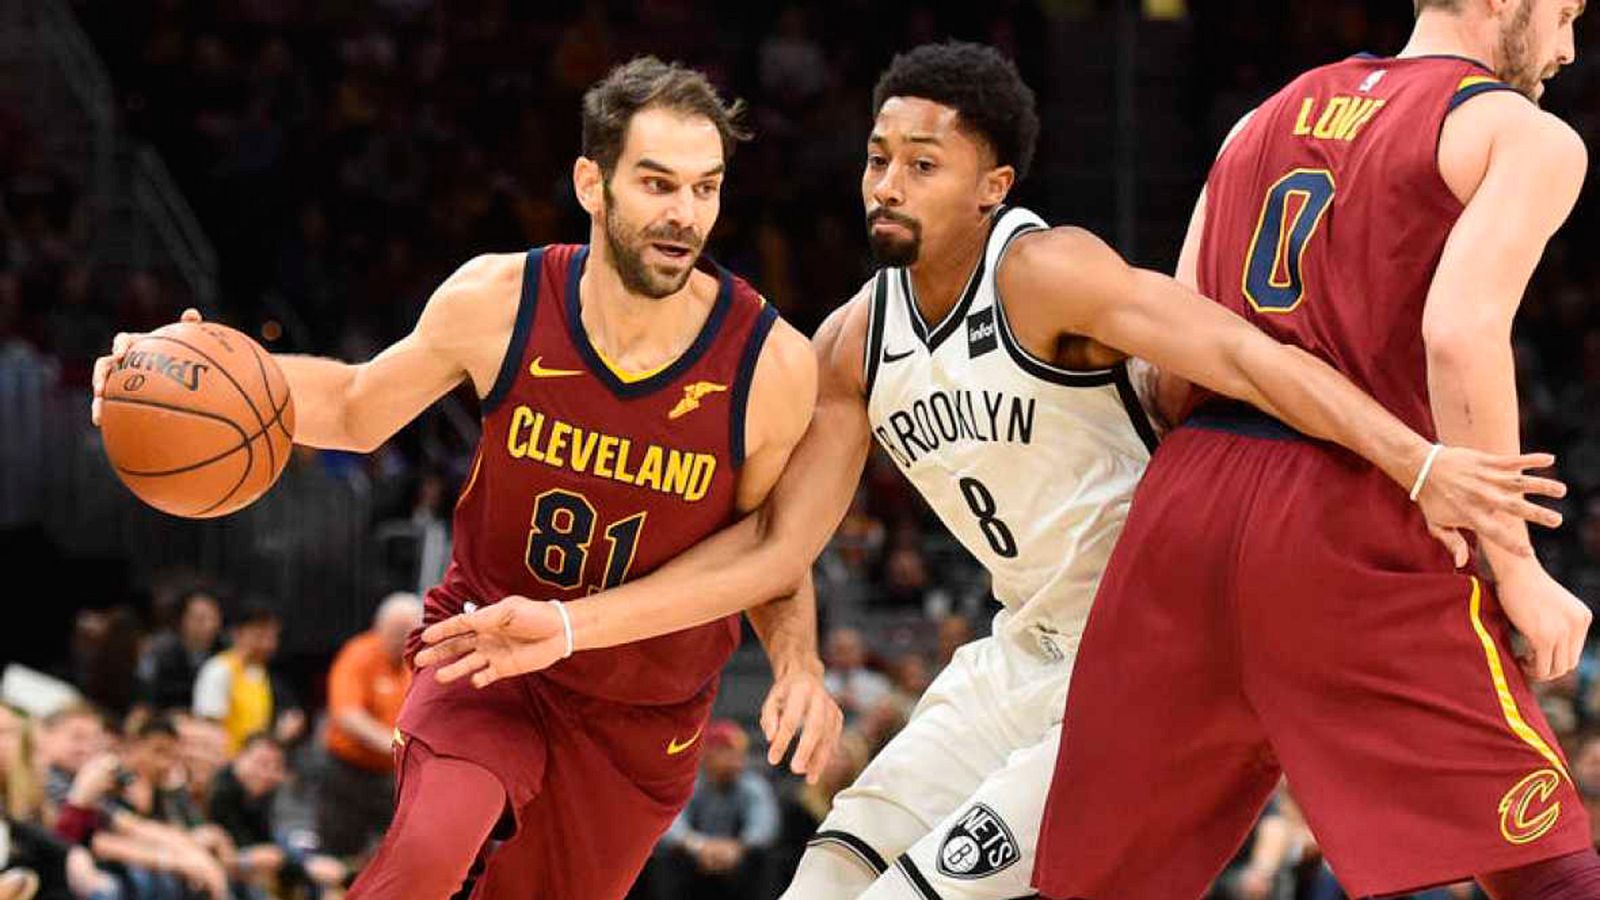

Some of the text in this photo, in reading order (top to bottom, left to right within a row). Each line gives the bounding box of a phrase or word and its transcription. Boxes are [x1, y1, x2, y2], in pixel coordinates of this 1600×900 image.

[1242, 168, 1336, 312] 0
[507, 405, 717, 502] CLEVELAND
[876, 389, 1036, 468] BROOKLYN
[525, 488, 648, 596] 81
[959, 477, 1019, 558] 8
[958, 807, 1013, 867] NETS
